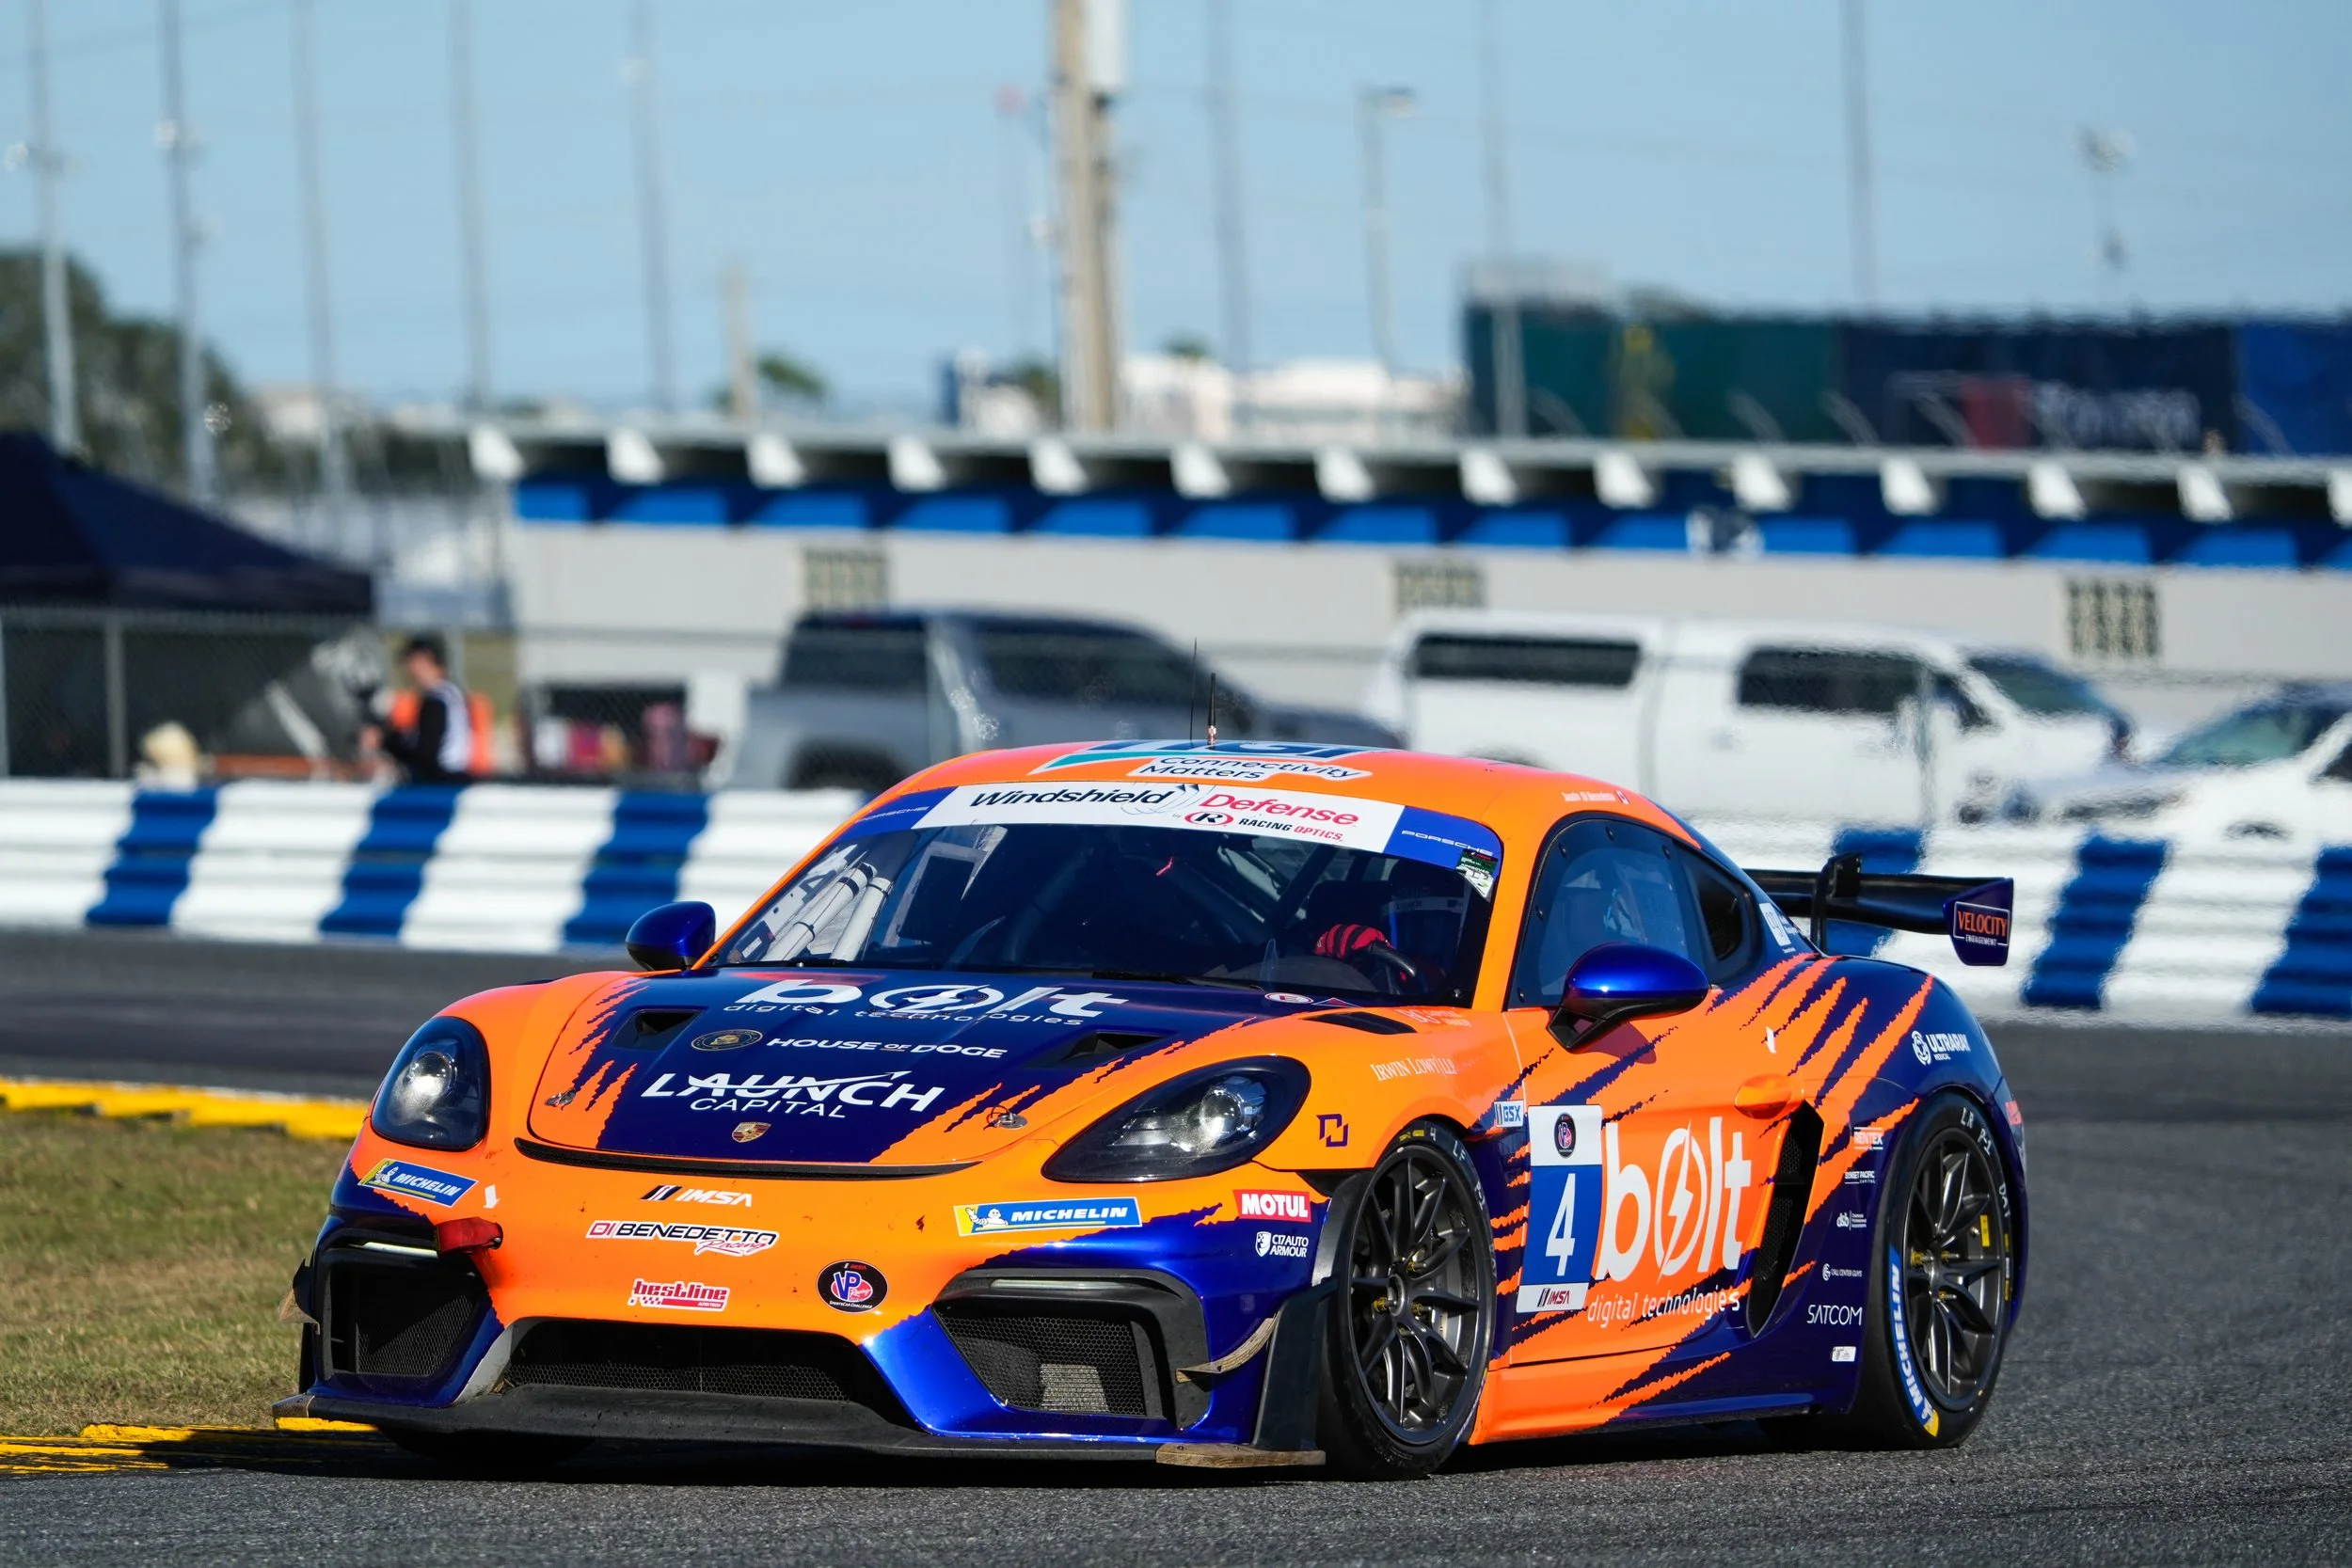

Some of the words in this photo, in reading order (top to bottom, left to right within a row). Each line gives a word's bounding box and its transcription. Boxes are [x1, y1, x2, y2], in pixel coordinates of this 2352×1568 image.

[1140, 764, 1262, 780] Matters
[1160, 756, 1363, 779] Connectivity
[969, 788, 1175, 807] Windshield
[1200, 793, 1359, 825] Defense
[1238, 818, 1293, 832] RACING
[1401, 830, 1493, 856] PORSCHE
[1958, 911, 2008, 937] VELOCITY
[735, 979, 1129, 1017] bolt
[723, 1004, 838, 1016] digital
[766, 1037, 882, 1051] HOUSE
[882, 1043, 911, 1052] OF
[911, 1044, 1009, 1059] DOGE
[1925, 1033, 1971, 1053] ULTRARAY
[1370, 1059, 1411, 1082] IRWIN
[1406, 1057, 1438, 1075] LOWY
[641, 1070, 945, 1113] LAUNCH
[690, 1098, 846, 1118] CAPITAL
[1503, 1105, 1521, 1122] GSX
[1961, 1107, 1975, 1129] LR
[392, 1173, 462, 1196] MICHELIN
[675, 1188, 753, 1208] IMSA
[1241, 1193, 1309, 1218] MOTUL
[1595, 1117, 1752, 1284] bolt
[1010, 1206, 1129, 1222] MICHELIN
[1545, 1173, 1576, 1276] 4
[589, 1222, 617, 1236] DI
[616, 1223, 777, 1245] BENEDETTO
[696, 1239, 767, 1254] Racing
[1269, 1244, 1308, 1258] ARMOUR
[633, 1280, 727, 1300] bestline
[834, 1270, 862, 1302] VP
[1547, 1290, 1570, 1305] IMSA
[1587, 1291, 1638, 1328] digital
[1642, 1285, 1740, 1321] technologies
[1806, 1304, 1863, 1325] SATCOM
[1891, 1263, 1924, 1409] MICHELIN
